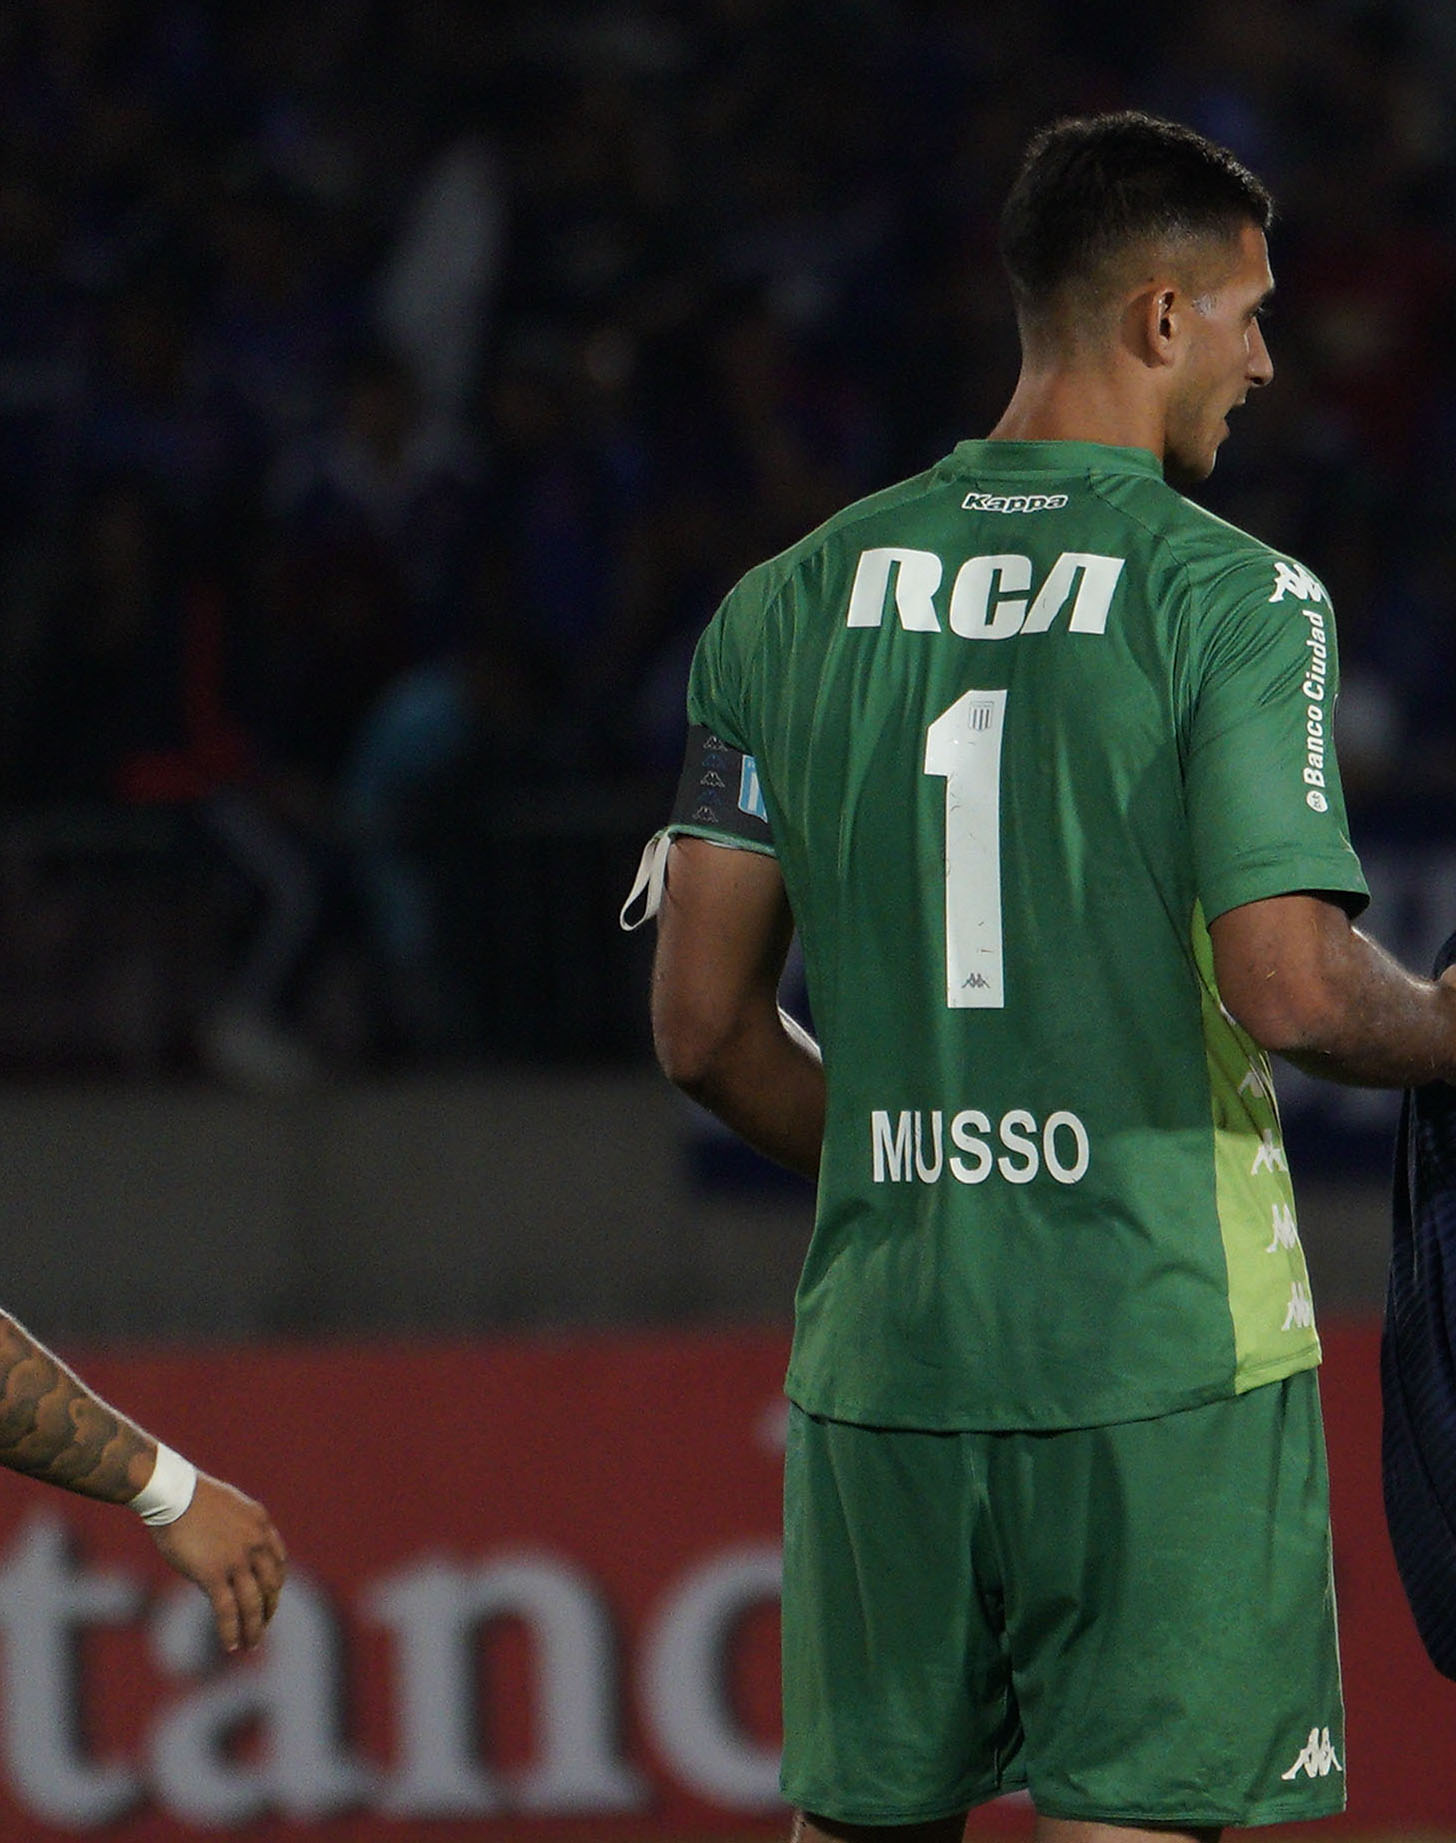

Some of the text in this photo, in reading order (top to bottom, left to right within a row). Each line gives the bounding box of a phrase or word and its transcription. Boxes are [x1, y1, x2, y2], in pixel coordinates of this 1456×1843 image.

[961, 493, 1068, 513] Kappa
[847, 548, 1125, 639] RCA
[1302, 610, 1326, 702] Ciudad
[1303, 704, 1326, 787] Banco
[924, 690, 1008, 1009] 1
[871, 1110, 1089, 1184] MUSSO
